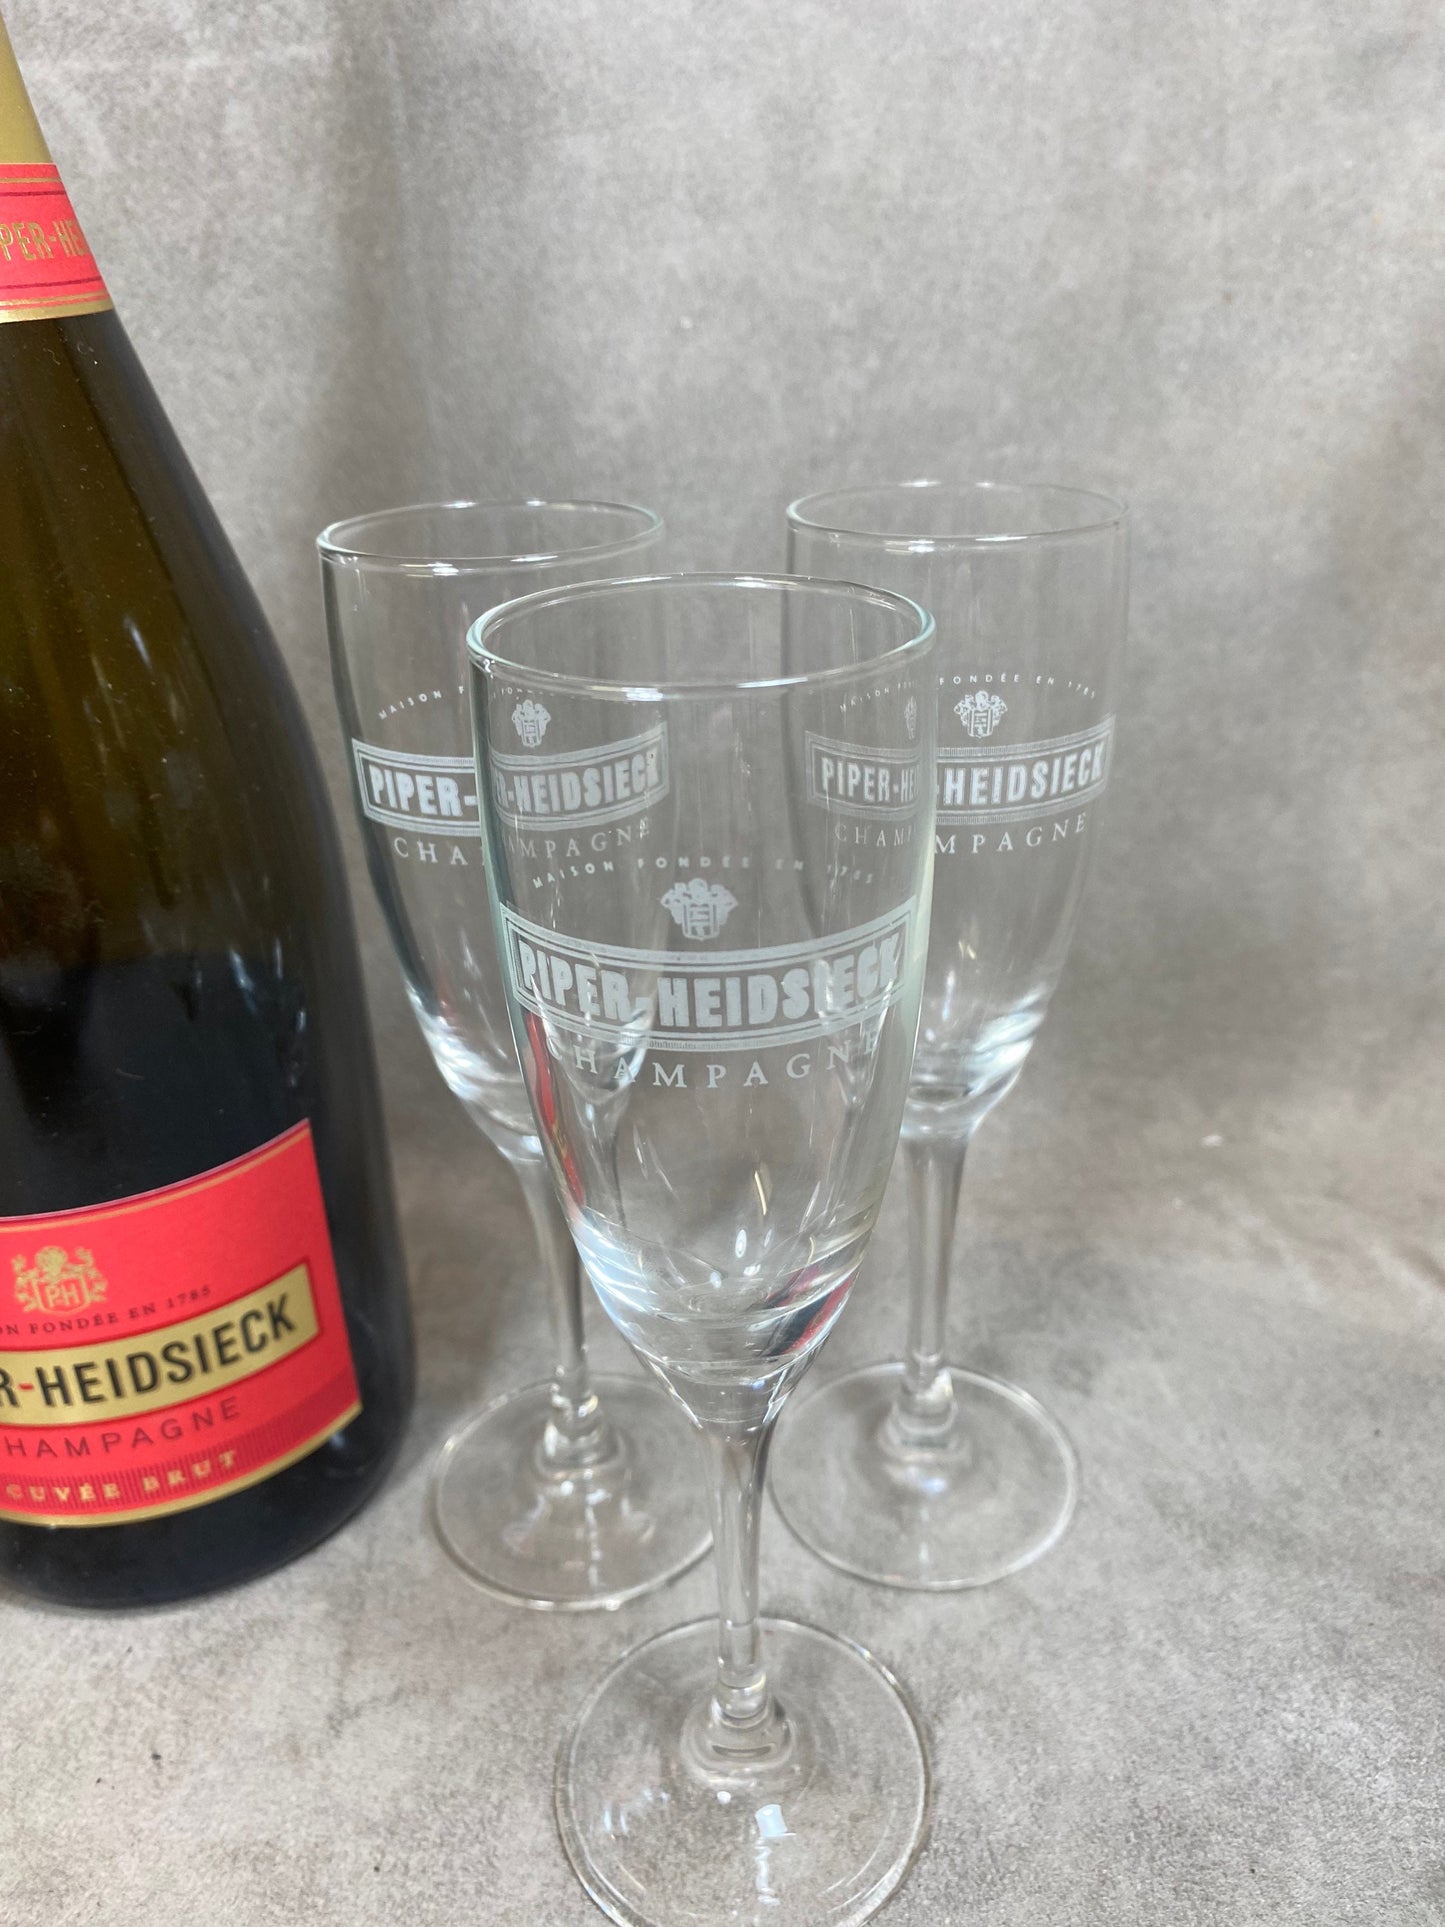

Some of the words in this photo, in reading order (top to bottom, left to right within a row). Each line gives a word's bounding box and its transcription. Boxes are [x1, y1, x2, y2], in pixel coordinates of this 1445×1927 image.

[1035, 675, 1055, 686] EN
[377, 689, 443, 720] MAISON
[532, 861, 615, 888] MAISON
[775, 858, 804, 871] EN
[29, 1313, 119, 1334] FONDÉE
[129, 1302, 156, 1319] EN
[167, 1285, 212, 1308] 1785
[4, 1396, 241, 1458] HAMPAGNE
[142, 1449, 238, 1492] BRUT
